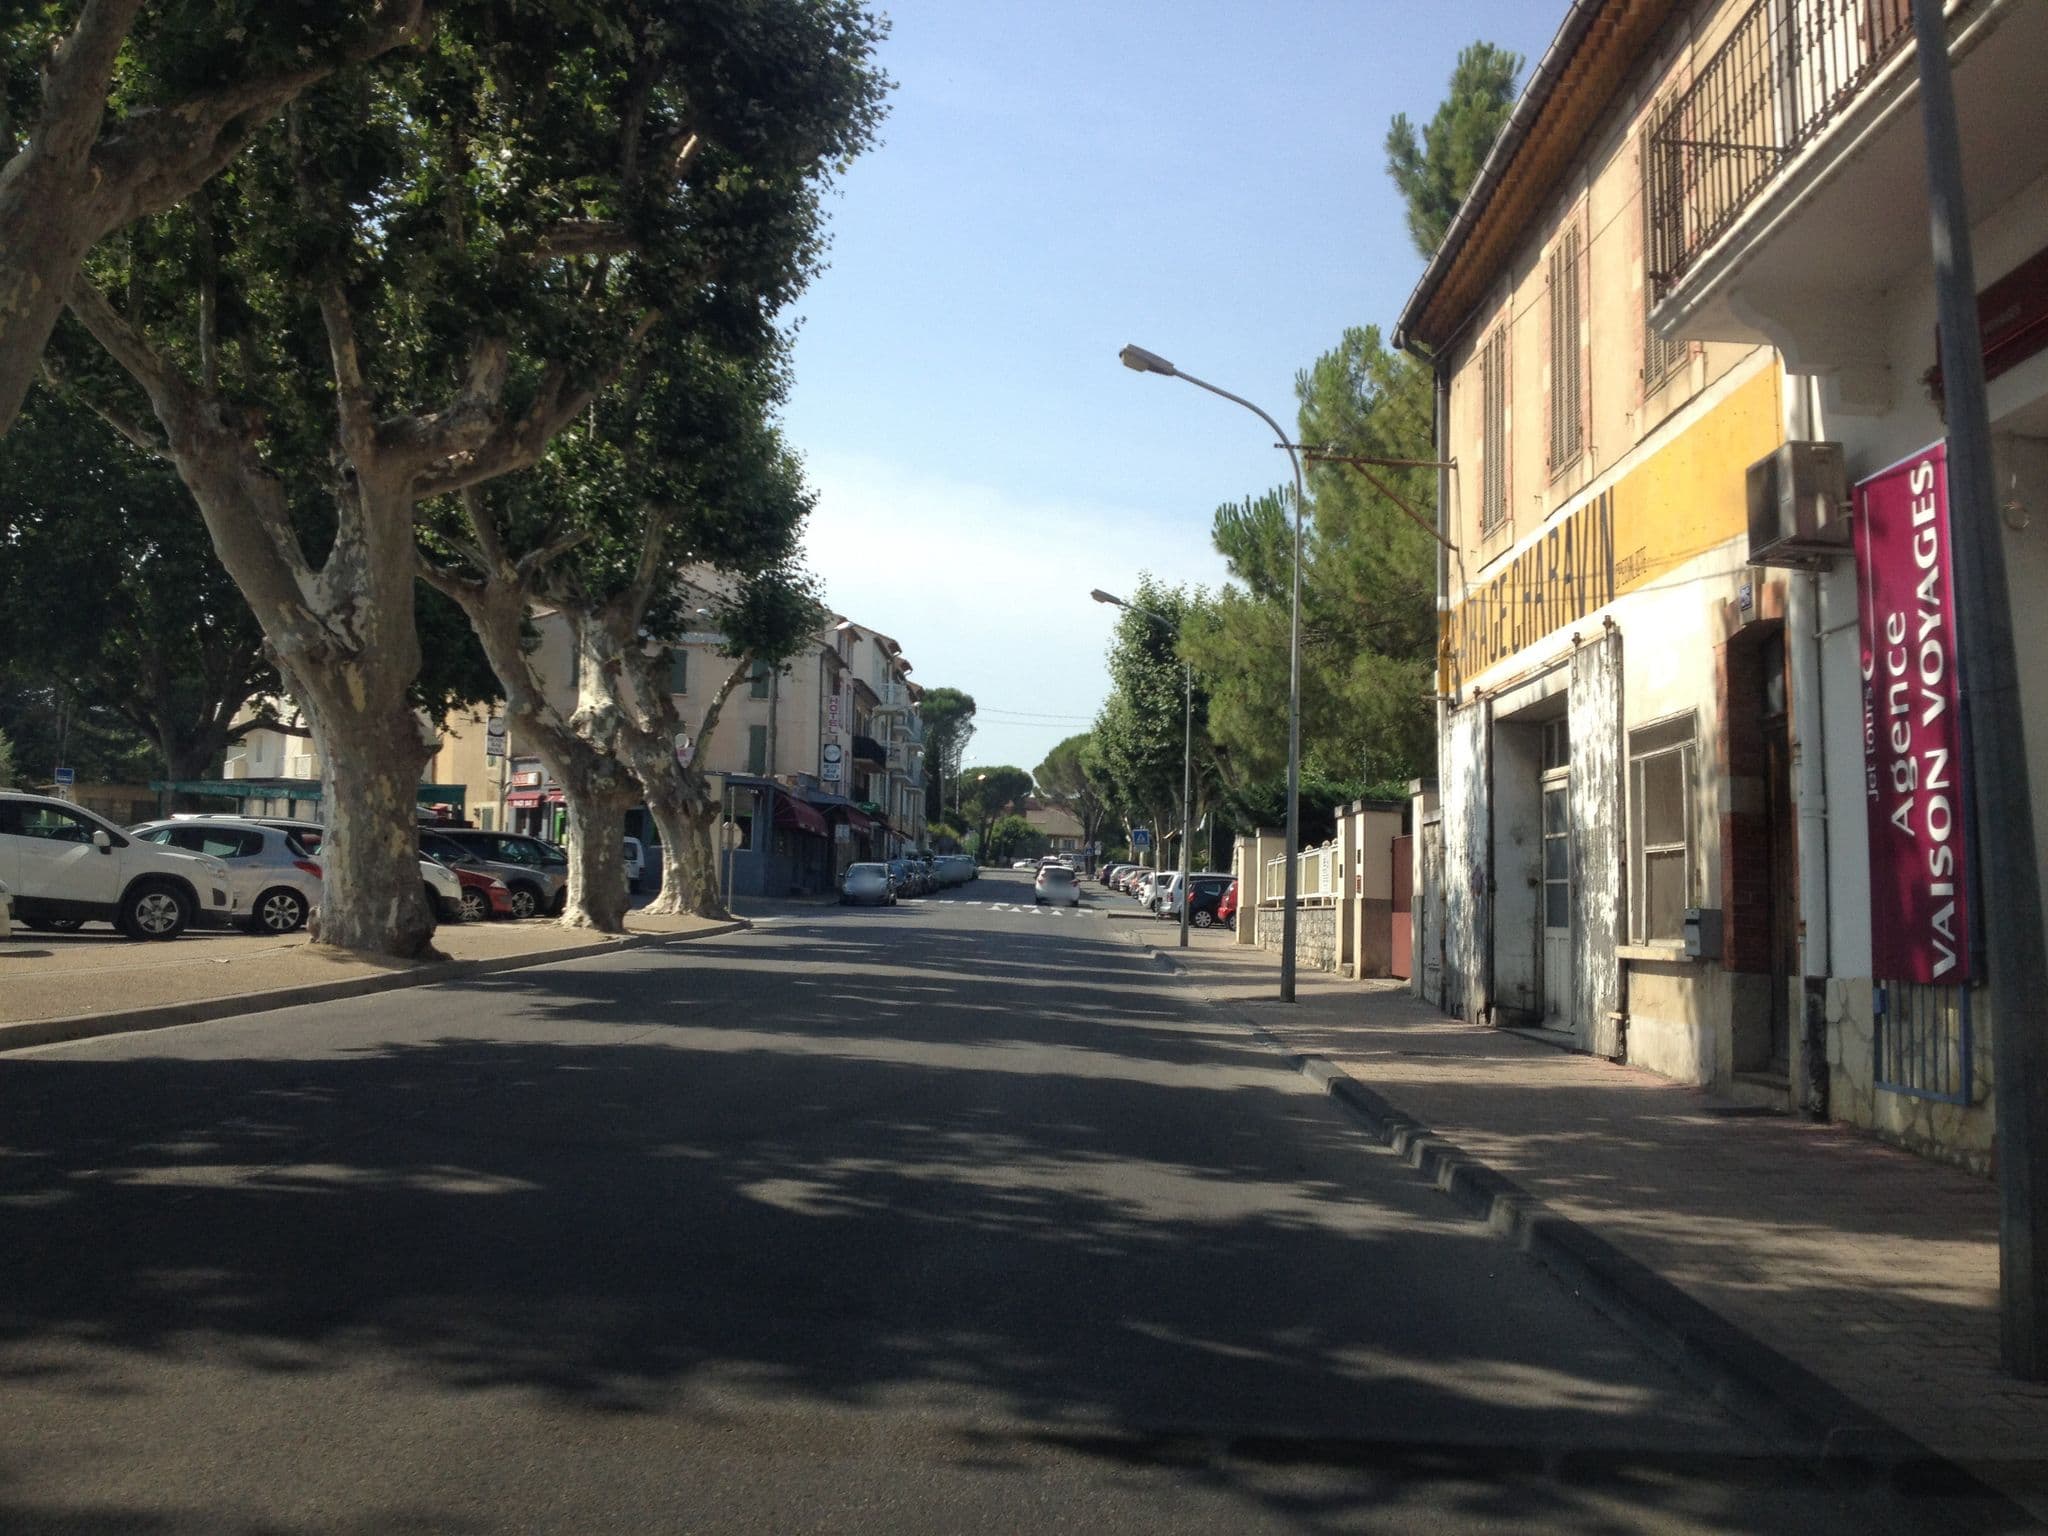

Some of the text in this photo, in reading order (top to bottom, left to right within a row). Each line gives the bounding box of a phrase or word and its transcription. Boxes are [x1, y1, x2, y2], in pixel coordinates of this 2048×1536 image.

[829, 697, 839, 734] HOTEL
[1864, 686, 1875, 755] tours
[1888, 612, 1917, 836] Agence
[1911, 460, 1956, 978] VAISON VOYAGES
